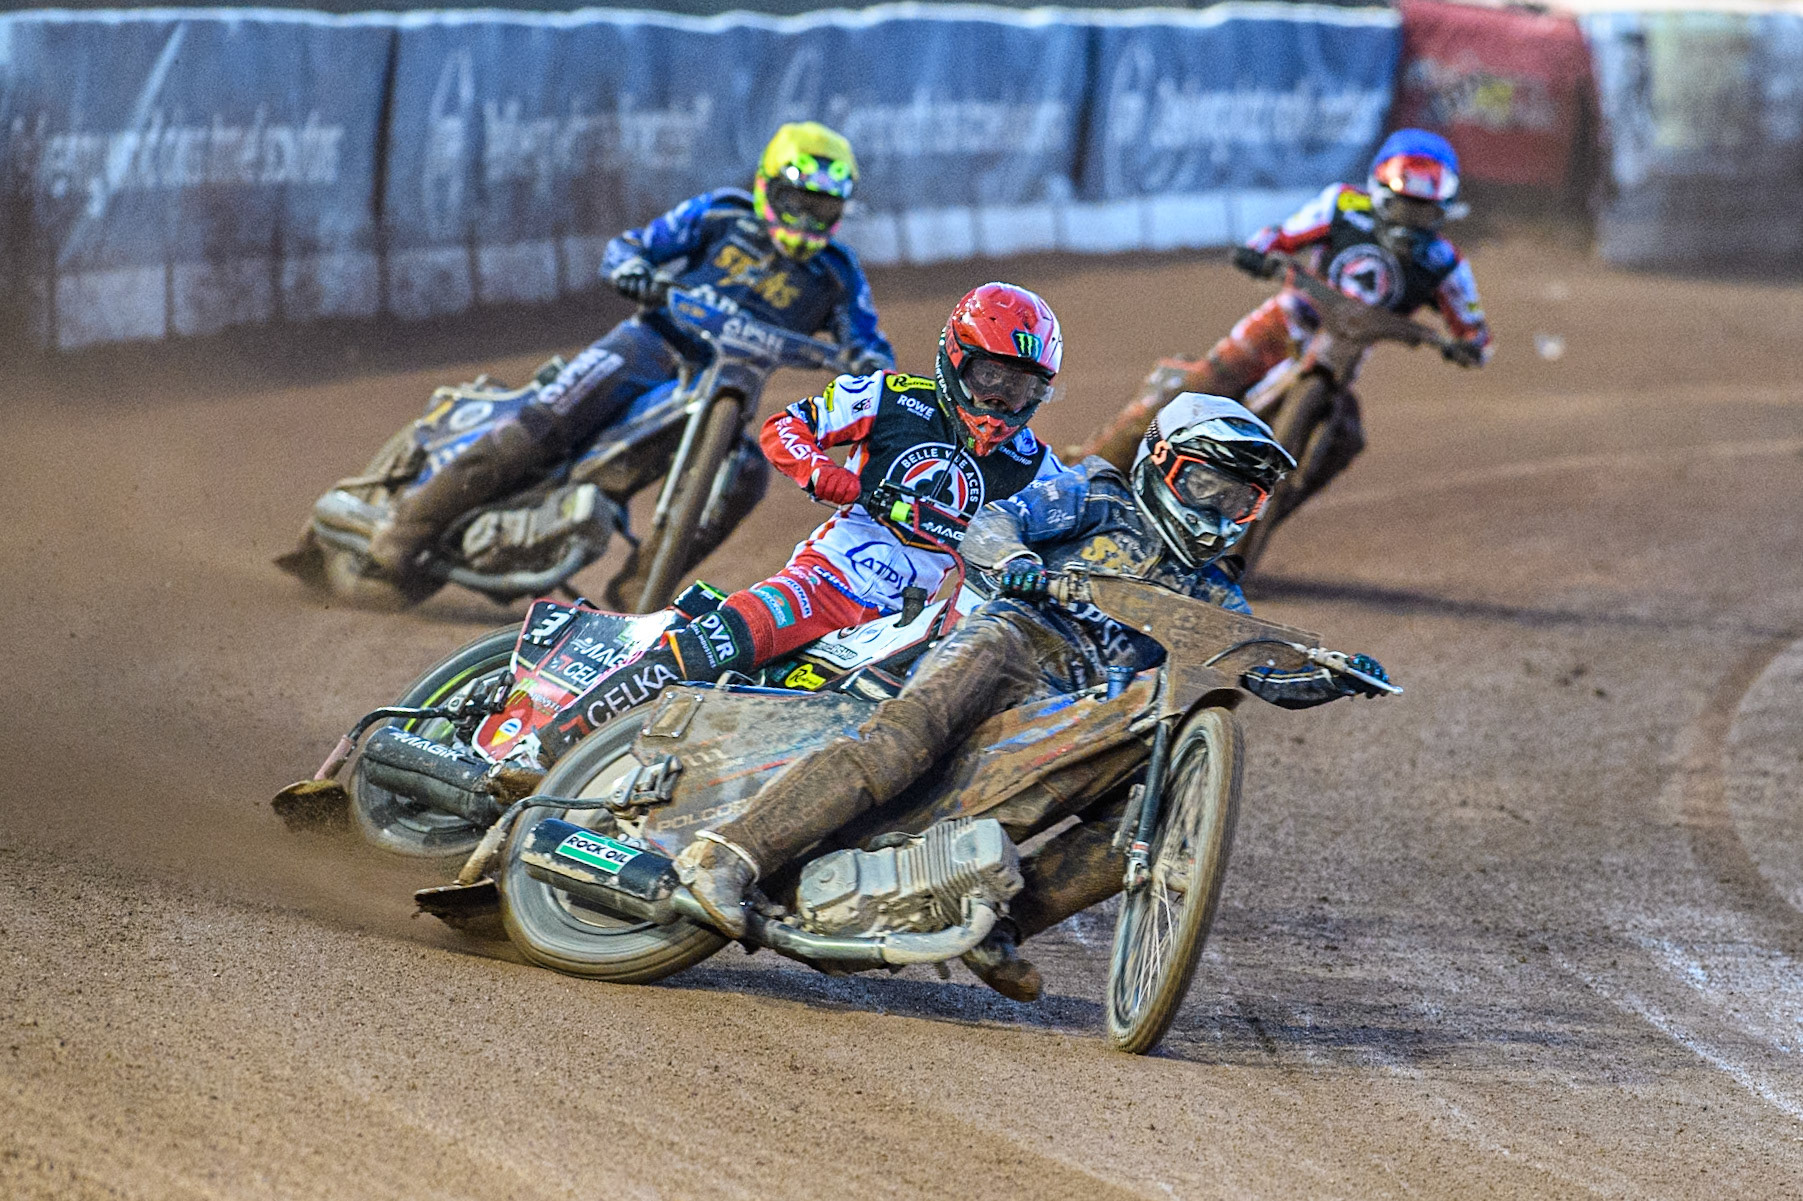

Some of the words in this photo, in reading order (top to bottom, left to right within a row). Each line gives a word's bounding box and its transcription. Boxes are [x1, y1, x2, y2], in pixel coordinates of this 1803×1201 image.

[896, 394, 936, 417] ROWE
[901, 447, 939, 469] BELLE
[965, 471, 979, 503] ACES
[931, 523, 966, 541] MAG
[859, 557, 904, 590] ATPI
[698, 634, 717, 668] INDUSTRIES
[700, 614, 735, 661] DVR
[563, 661, 601, 686] CEL
[587, 663, 679, 728] CELKA
[566, 836, 606, 855] ROCK
[605, 850, 628, 863] OIL
